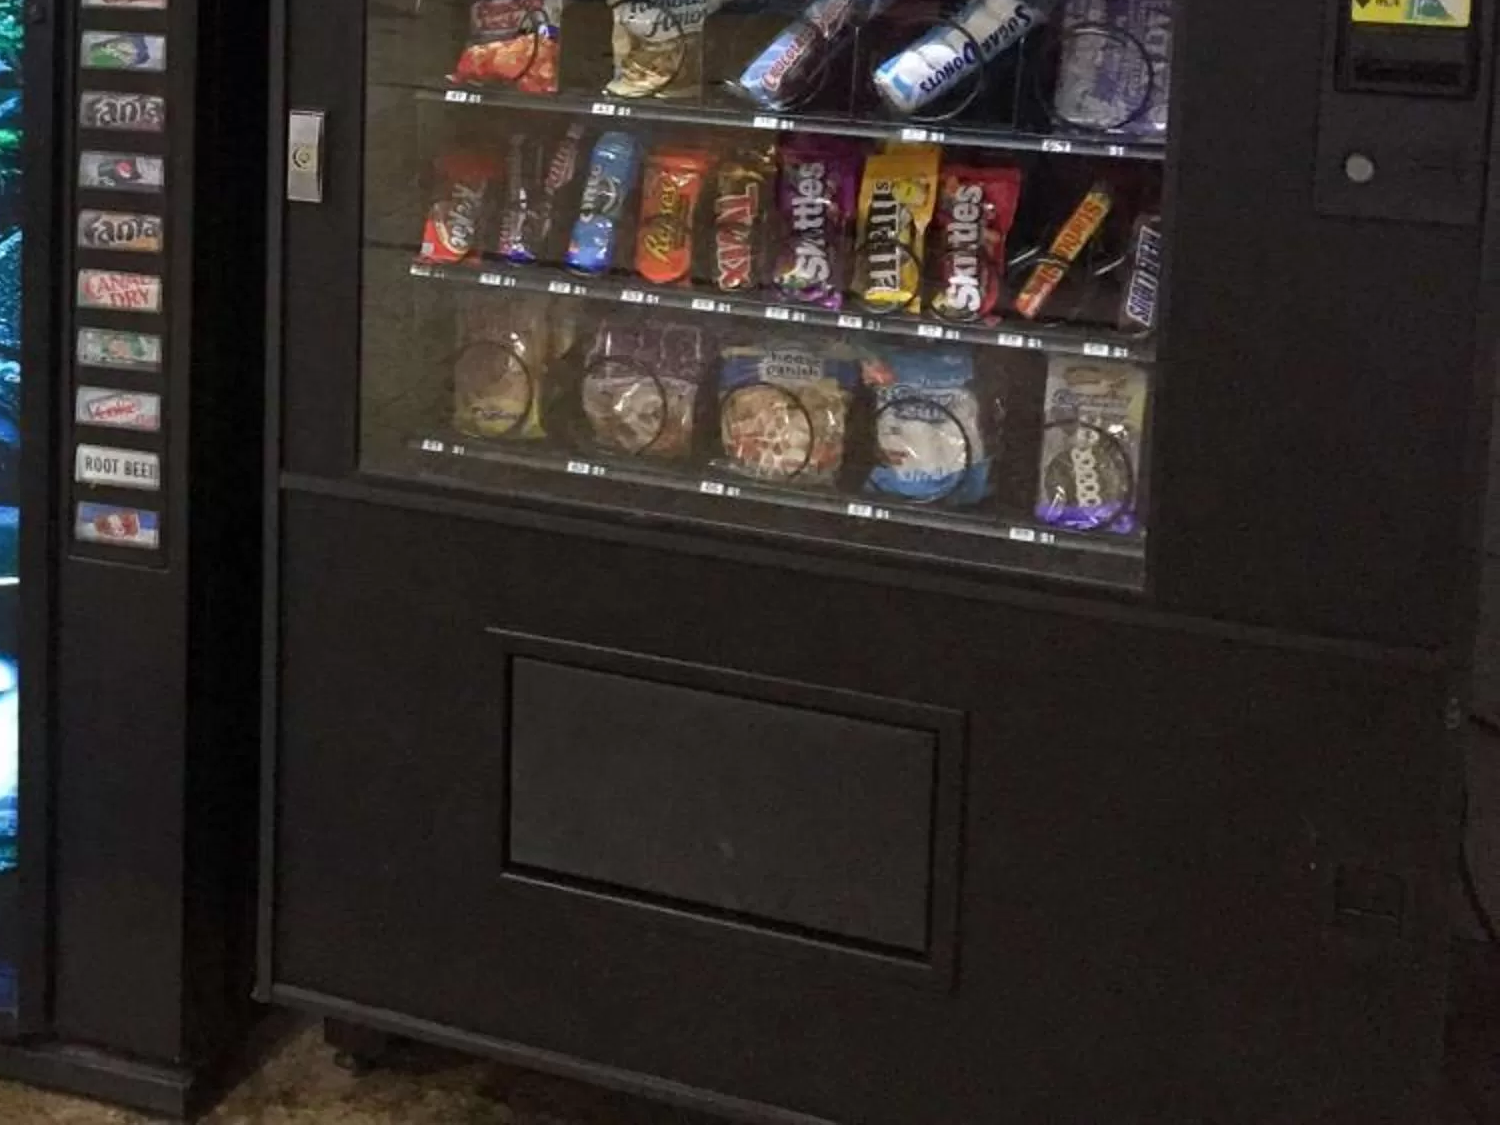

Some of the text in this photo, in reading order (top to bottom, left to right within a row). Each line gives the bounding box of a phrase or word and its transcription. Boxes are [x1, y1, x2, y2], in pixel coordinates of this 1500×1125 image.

[919, 4, 1034, 95] SUGAR DONUTS
[84, 454, 119, 475] ROOT
